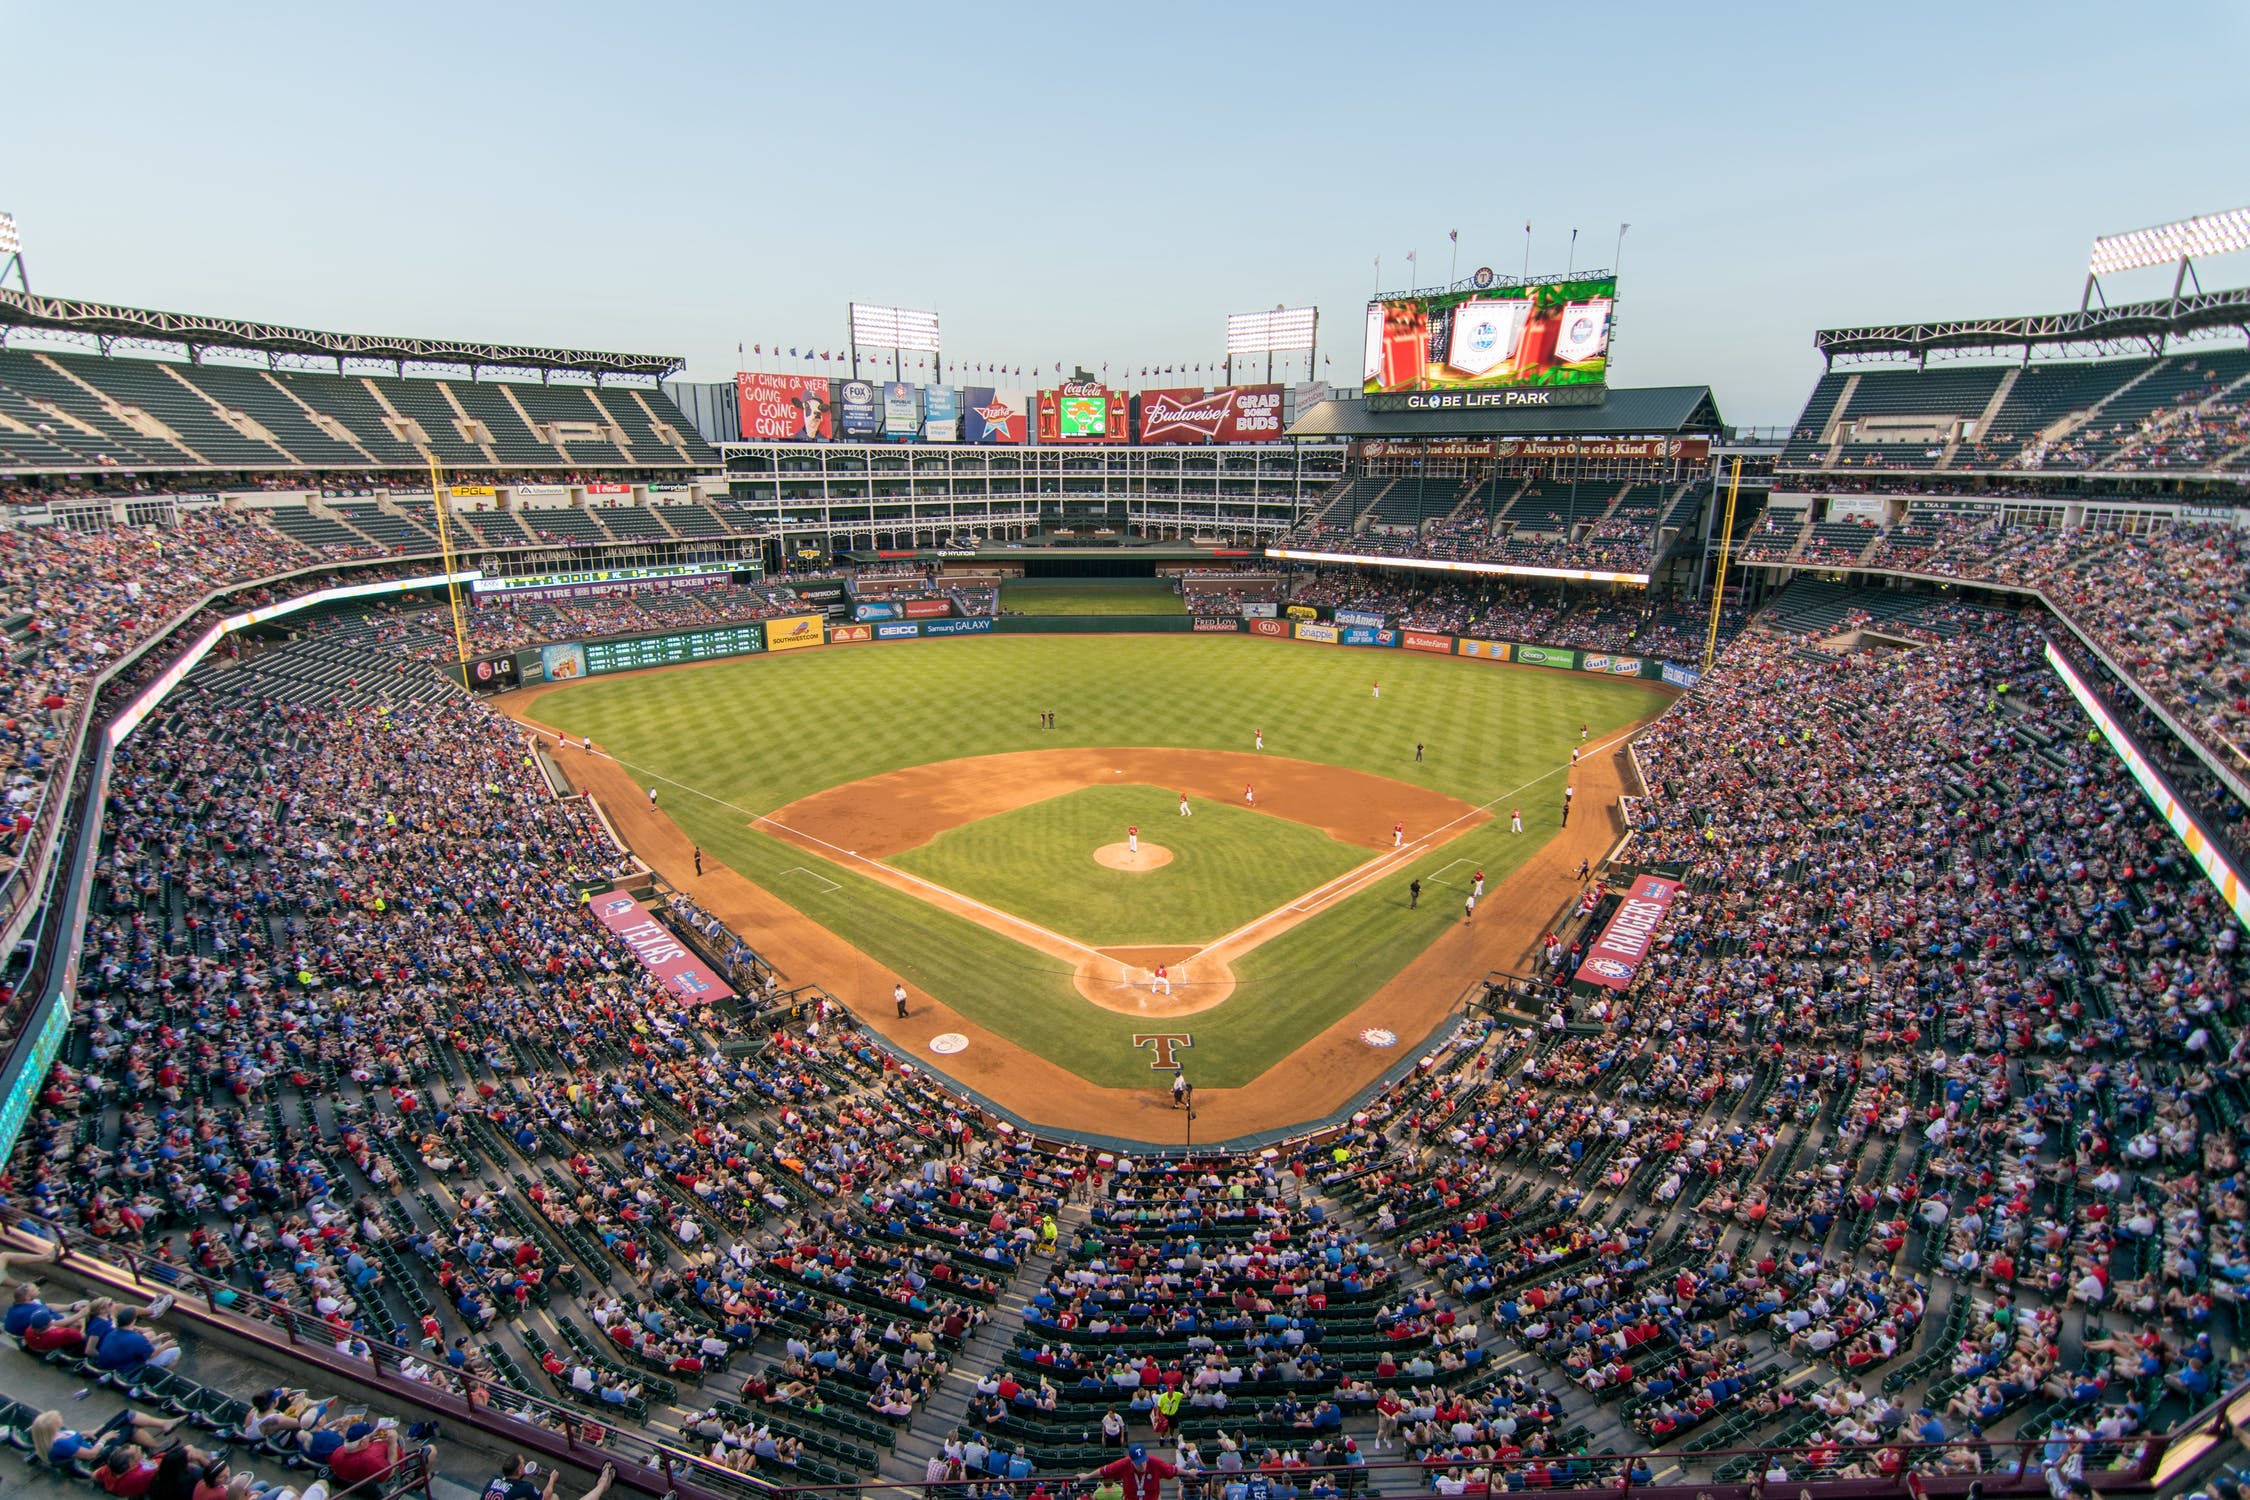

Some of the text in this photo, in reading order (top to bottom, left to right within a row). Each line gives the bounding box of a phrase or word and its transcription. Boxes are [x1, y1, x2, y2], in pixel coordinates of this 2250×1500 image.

[739, 374, 828, 392] EAT CHIKIN OR WEER
[1064, 382, 1102, 396] Coca-Cola
[745, 387, 780, 402] GOING
[849, 386, 866, 396] FOX
[1236, 394, 1280, 409] GRAB
[1407, 392, 1550, 409] GLOBE LIFE PARK
[759, 402, 797, 419] GOING
[982, 407, 1010, 419] Ozarka
[1145, 405, 1230, 424] Budweiser
[1243, 408, 1272, 416] SOME
[755, 418, 795, 437] GONE
[1236, 416, 1279, 431] BUDS
[1386, 444, 1422, 456] Always
[1463, 443, 1490, 454] Kind
[1523, 443, 1566, 456] Always
[1615, 443, 1648, 454] Kind
[460, 487, 486, 495] PGL
[591, 583, 629, 595] NEXEN
[671, 577, 705, 588] NEXEN
[501, 588, 572, 603] NEXEN TIRE
[1194, 617, 1237, 625] FRED LOYA
[1335, 612, 1356, 624] Cash
[879, 625, 918, 636] GEICO
[928, 620, 990, 633] Samsung GALAXY
[1261, 624, 1277, 632] KIA
[1300, 626, 1334, 639] Snapple
[494, 660, 511, 674] LG
[1585, 659, 1608, 668] Gulf
[1615, 663, 1639, 672] Gulf
[1600, 899, 1664, 956] RANGERS
[619, 920, 687, 965] TEXAS
[1132, 1033, 1194, 1070] T
[490, 1477, 513, 1493] YOUNG
